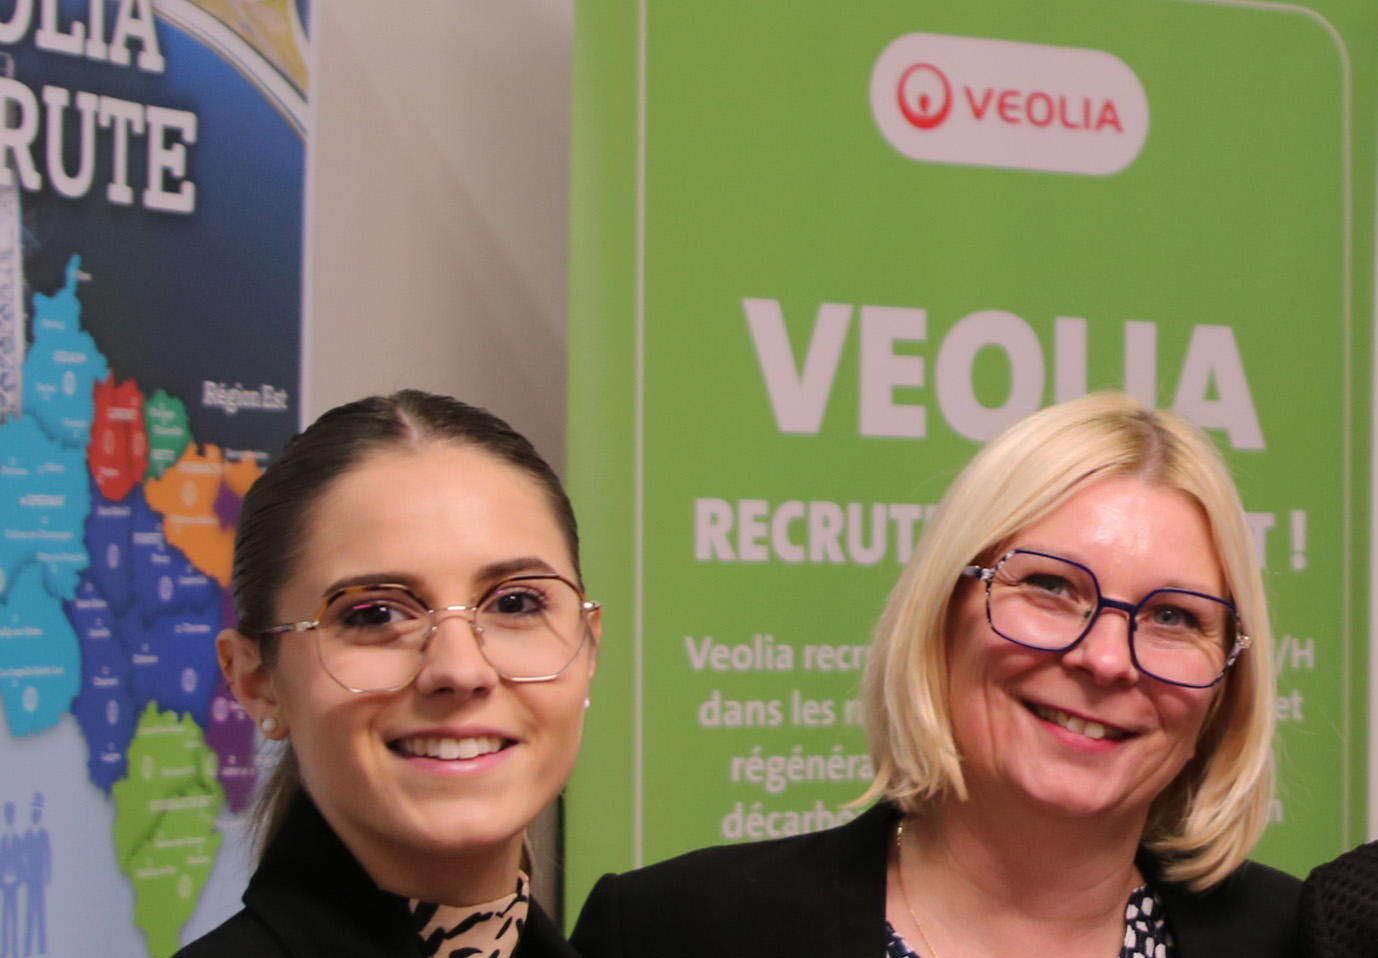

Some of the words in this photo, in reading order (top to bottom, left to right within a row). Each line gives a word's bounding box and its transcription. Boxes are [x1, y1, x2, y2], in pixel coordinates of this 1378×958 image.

[963, 85, 1124, 135] VEOLIA
[203, 380, 259, 416] Région
[262, 385, 289, 410] Est
[694, 497, 938, 564] RECRUT
[684, 635, 795, 671] Veolia
[804, 644, 874, 671] recr
[699, 690, 784, 727] dans
[792, 689, 836, 726] les
